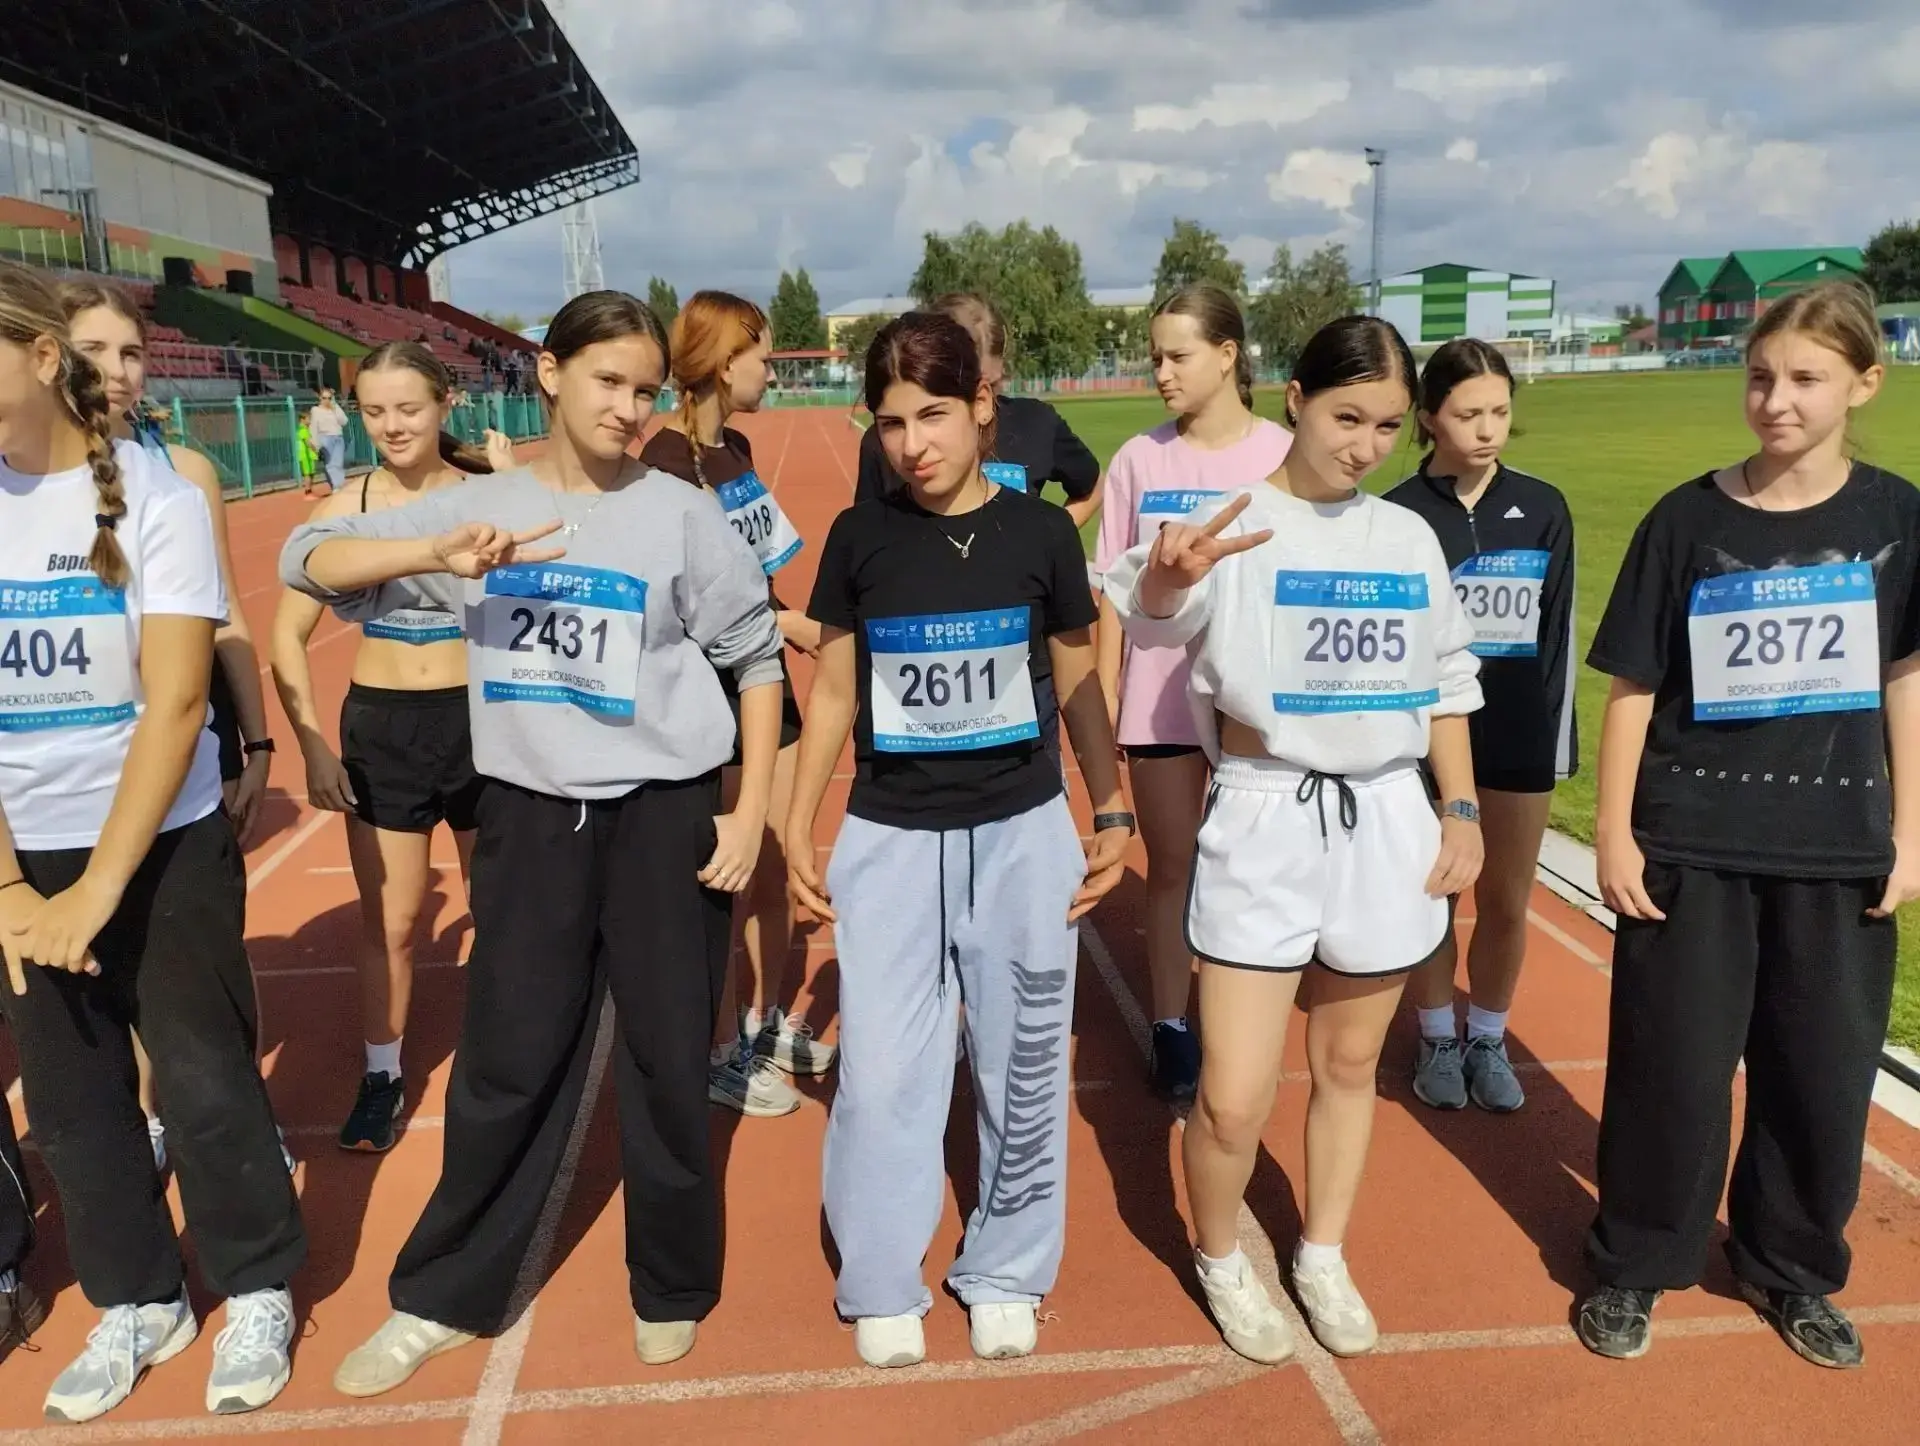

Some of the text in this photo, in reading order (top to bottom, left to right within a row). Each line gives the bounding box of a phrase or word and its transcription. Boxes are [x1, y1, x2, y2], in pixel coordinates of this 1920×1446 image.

[1476, 556, 1516, 567] КРОСС
[542, 572, 593, 591] КРОСС
[1335, 579, 1379, 594] КРОСС
[1752, 577, 1809, 595] КРОСС
[2, 588, 60, 604] КРОСС
[541, 586, 592, 599] НАЦИИ
[1454, 584, 1531, 619] 2300
[509, 608, 608, 663] 2431
[925, 621, 976, 638] КРОСС
[926, 637, 977, 645] НАЦИИ
[1304, 617, 1406, 663] 2665
[1725, 614, 1845, 668] 2872
[0, 628, 91, 677] 404
[512, 668, 607, 691] ВОРОНЕЖСКАЯ ОБЛАСТЬ
[899, 657, 996, 707] 2611
[1305, 680, 1408, 691] ВОРОНЕЖСКАЯ ОБЛАСТЬ
[47, 690, 95, 704] ОБЛАСТЬ
[1727, 681, 1801, 697] ВОРОНЕЖСКАЯ
[905, 714, 1009, 735] ВОРОНЕЖСКАЯ ОБЛАСТЬ
[1671, 764, 1875, 788] DOBERMANN
